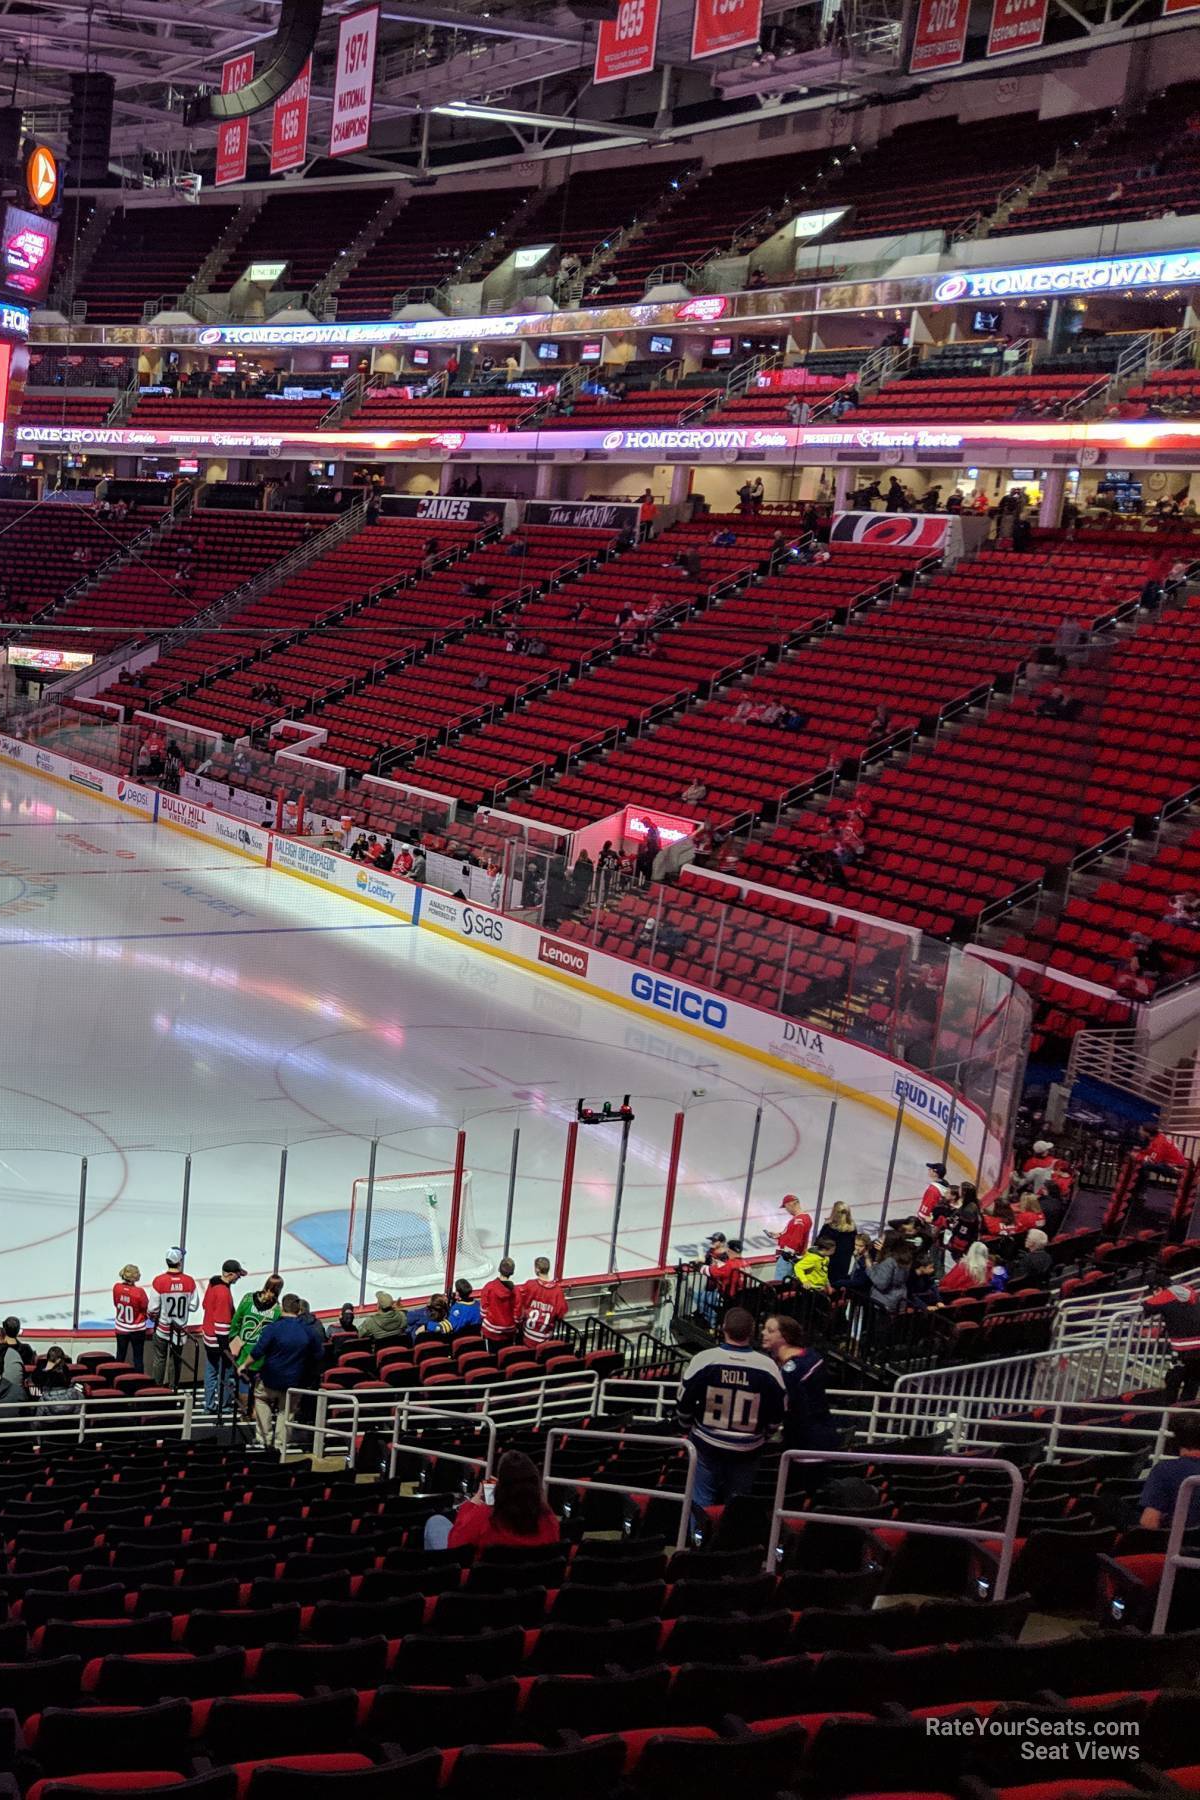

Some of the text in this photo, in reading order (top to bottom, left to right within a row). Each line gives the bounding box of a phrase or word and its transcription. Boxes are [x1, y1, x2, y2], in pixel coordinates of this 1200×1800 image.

[615, 1, 644, 40] 1955
[927, 3, 957, 33] 2012
[344, 30, 369, 75] 1974
[227, 62, 247, 94] ACC
[337, 86, 367, 113] NATIONAL
[333, 115, 368, 143] CHAMPIONS
[971, 259, 1166, 297] HOMEGROWN
[224, 328, 350, 344] HOMEGROWN
[223, 435, 252, 447] Harris
[252, 436, 283, 447] Teeter
[625, 430, 963, 448] HOMEGROWN Series PRESENTED BY Harris Teeter
[416, 499, 471, 521] CANES
[548, 504, 617, 527] TAKE WARNING
[127, 788, 149, 806] pepsi
[161, 797, 187, 815] BULLY
[188, 801, 207, 825] HILL
[168, 812, 200, 830] VINEYARDS
[215, 822, 263, 850] Michael Son
[275, 838, 337, 873] RALEIGH ORTHOPAEDIC
[367, 880, 397, 904] Lottery
[428, 899, 457, 916] ANALYTICS
[428, 907, 449, 921] POWERED
[474, 913, 504, 941] sas
[541, 941, 585, 970] Lenovo
[631, 972, 728, 1030] GEICO
[782, 1022, 825, 1054] DNA
[895, 1077, 966, 1136] BUD LIGHT
[169, 1282, 184, 1292] AHO
[116, 1302, 134, 1325] 20
[166, 1296, 188, 1319] 20
[526, 1309, 552, 1333] 87
[721, 1369, 750, 1386] ROLL
